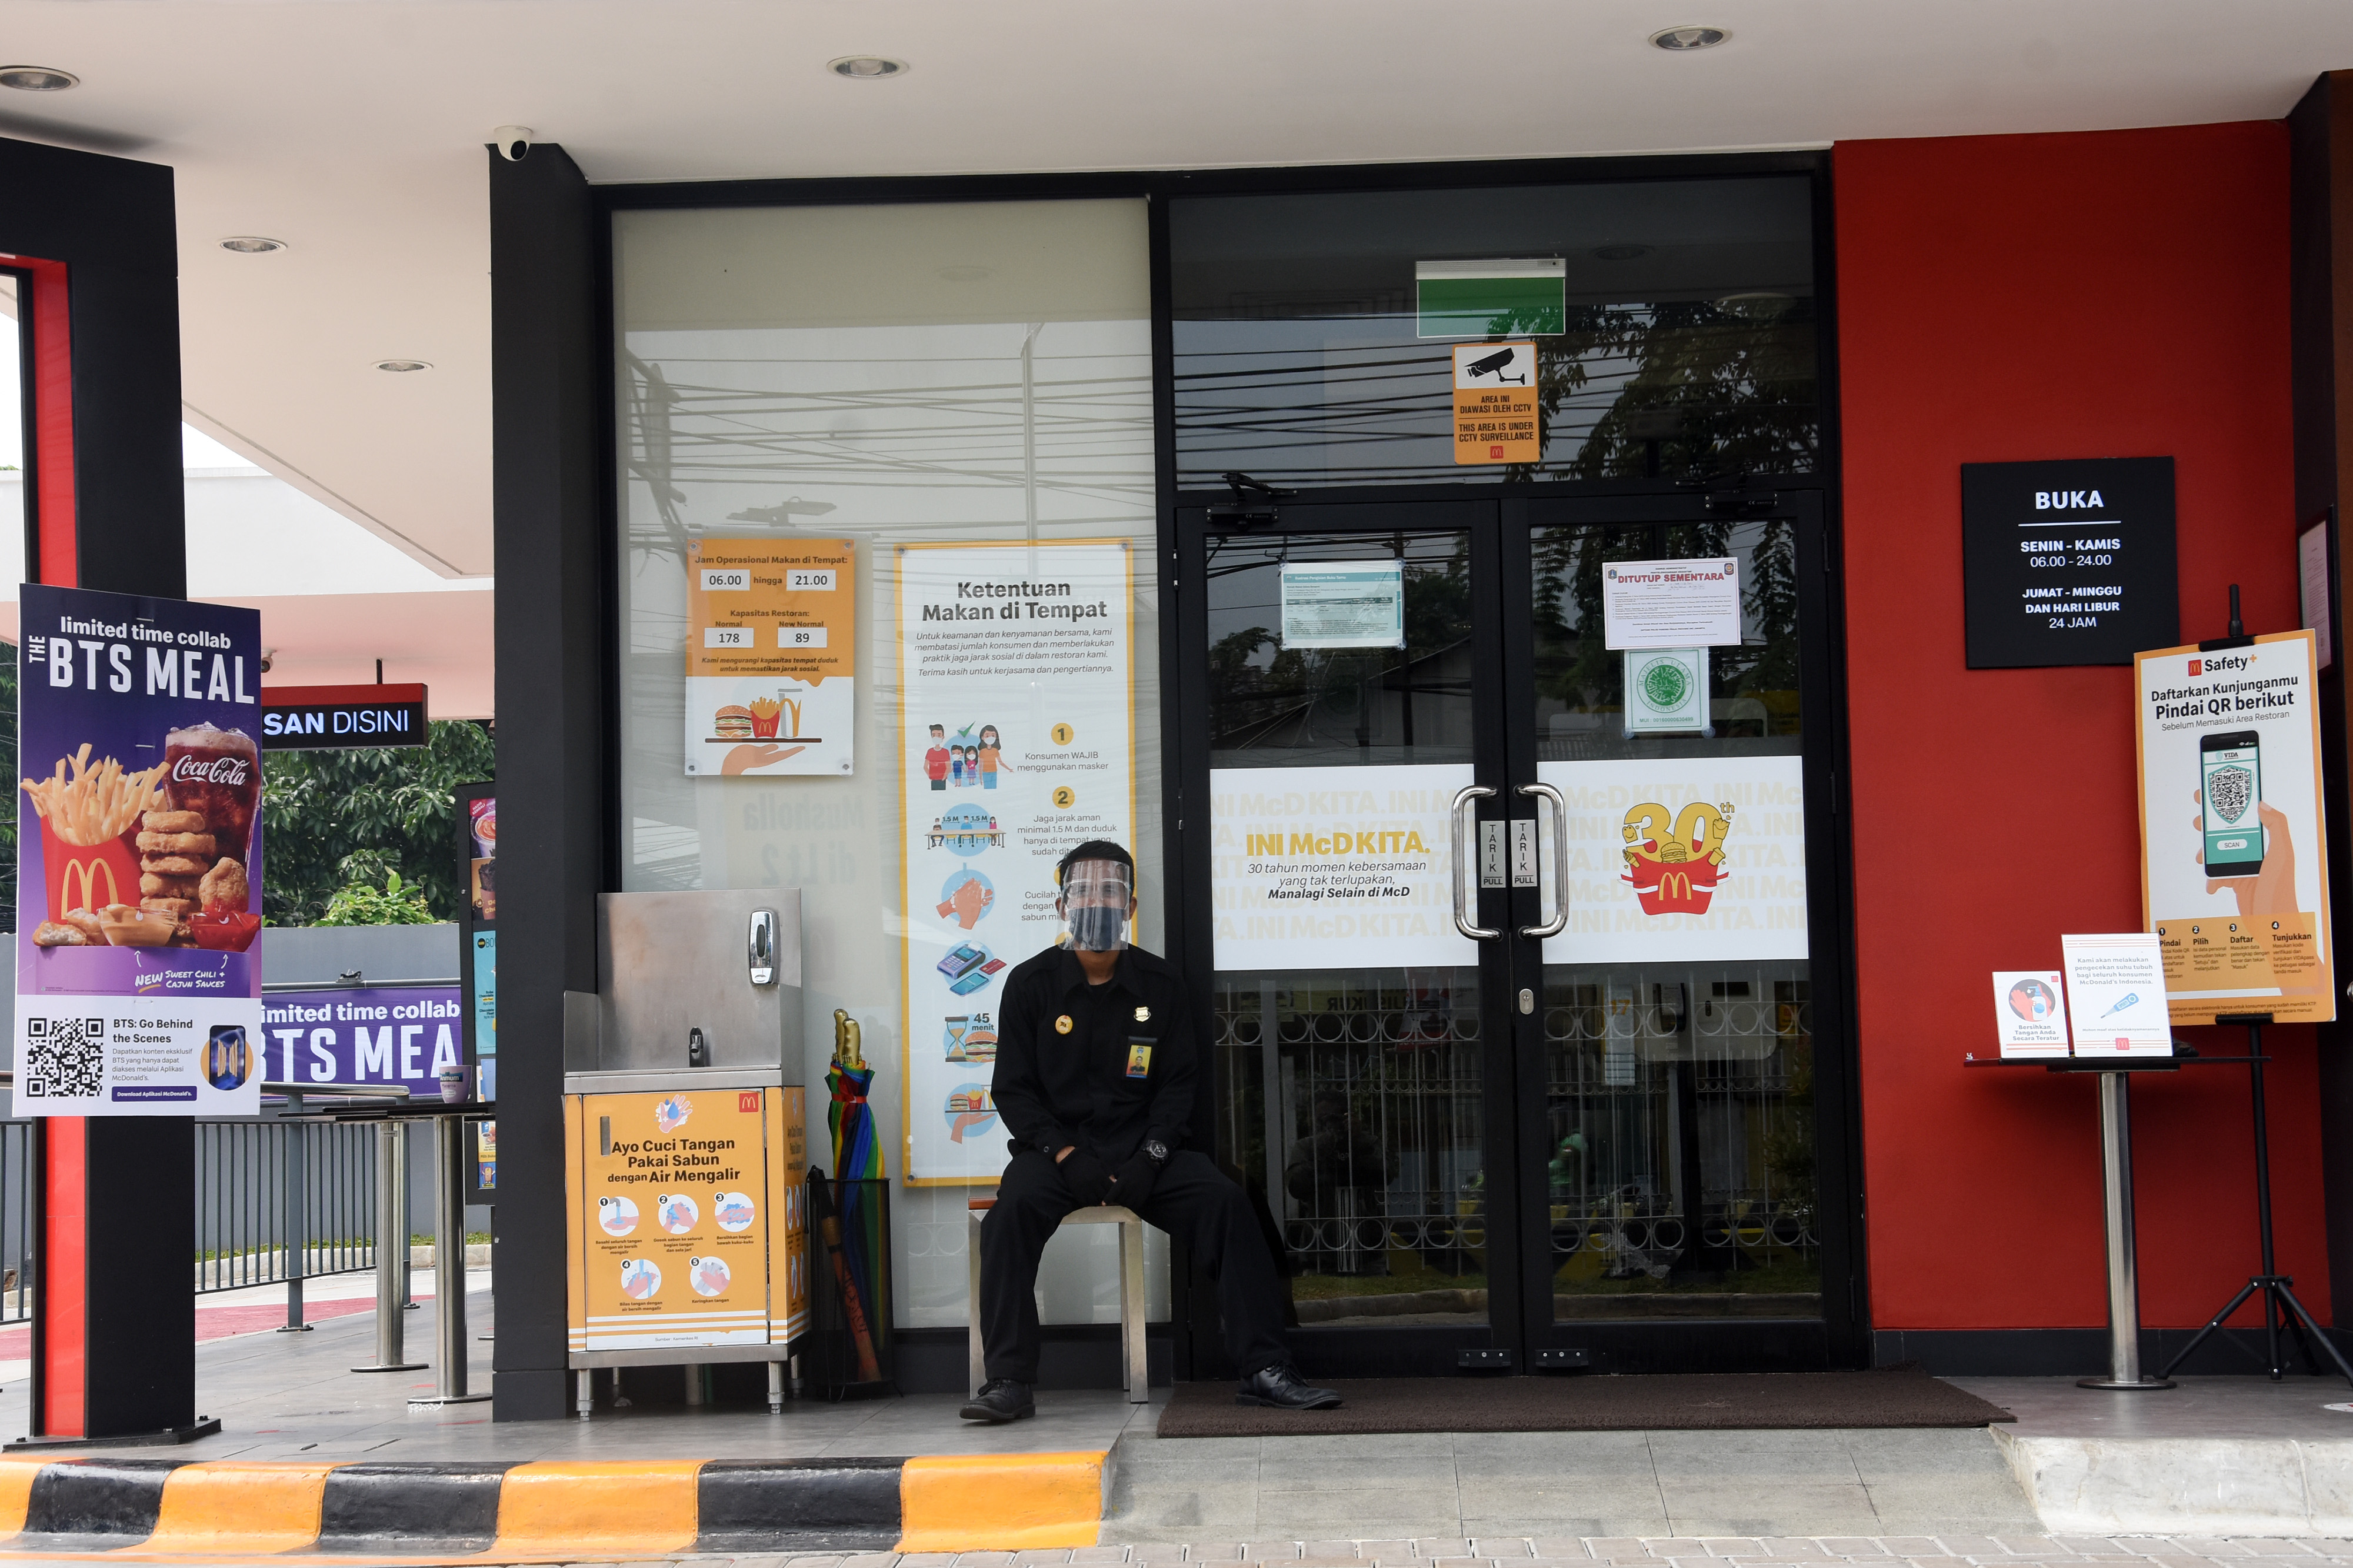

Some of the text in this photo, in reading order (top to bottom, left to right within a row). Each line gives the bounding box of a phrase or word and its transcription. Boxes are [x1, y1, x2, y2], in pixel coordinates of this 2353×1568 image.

[1460, 405, 1491, 413] DIAWASI
[1480, 432, 1534, 441] SURVEILLANCE
[2036, 491, 2104, 509] BUKA
[2021, 540, 2064, 552] SENIN
[2075, 539, 2121, 550] KAMIS
[716, 556, 769, 565] Operasional
[2031, 556, 2065, 567] 06.00
[2077, 555, 2111, 566] 24.00
[709, 575, 827, 585] 06.00 hingga 21.00
[1618, 573, 1724, 583] DITUTUP SEMENTARA
[958, 582, 1071, 598] Ketentuan
[2022, 588, 2063, 598] JUMAT
[2072, 586, 2122, 596] MINGGU
[922, 601, 1107, 622] Makan di Tempat
[2025, 602, 2119, 613] DAN HARI LIBUR
[2049, 617, 2097, 628] 24 JAM
[61, 616, 231, 649] limited time collab
[719, 633, 739, 643] 178
[795, 633, 809, 642] 89
[29, 635, 45, 663] THE
[50, 638, 254, 704] BTS MEAL
[1639, 659, 1691, 686] MAJELIS ULAMA
[2151, 677, 2298, 701] Daftarkan Kunjunganmu
[1647, 699, 1687, 712] INDONESIA
[2156, 691, 2294, 719] Pindai QR berikut
[334, 710, 408, 733] DISINI
[2162, 711, 2289, 731] Sebelum Memasuki Area Restoran
[1058, 728, 1065, 740] 1
[173, 755, 250, 786] Coca-Cola
[1017, 763, 1076, 772] menggunakan
[1247, 833, 1283, 856] INI
[1248, 863, 1262, 873] 30
[1265, 862, 1298, 873] tahun
[1349, 861, 1426, 872] kebersamaan
[1278, 875, 1395, 888] yang tak terlupakan,
[1268, 887, 1410, 901] Manalagi Selain di McD
[2272, 933, 2311, 942] Tunjukkan
[135, 972, 163, 987] NEW
[336, 1002, 387, 1020] time
[393, 1000, 459, 1018] collab
[114, 1019, 192, 1029] BTS: Go Behind
[974, 1013, 989, 1023] 45
[113, 1034, 171, 1043] the Scenes
[260, 1027, 336, 1082] TS
[612, 1138, 735, 1153] Ayo Cuci Tangan
[628, 1154, 719, 1167] Pakai Sabun
[608, 1169, 740, 1184] dengan Air Mengalir
